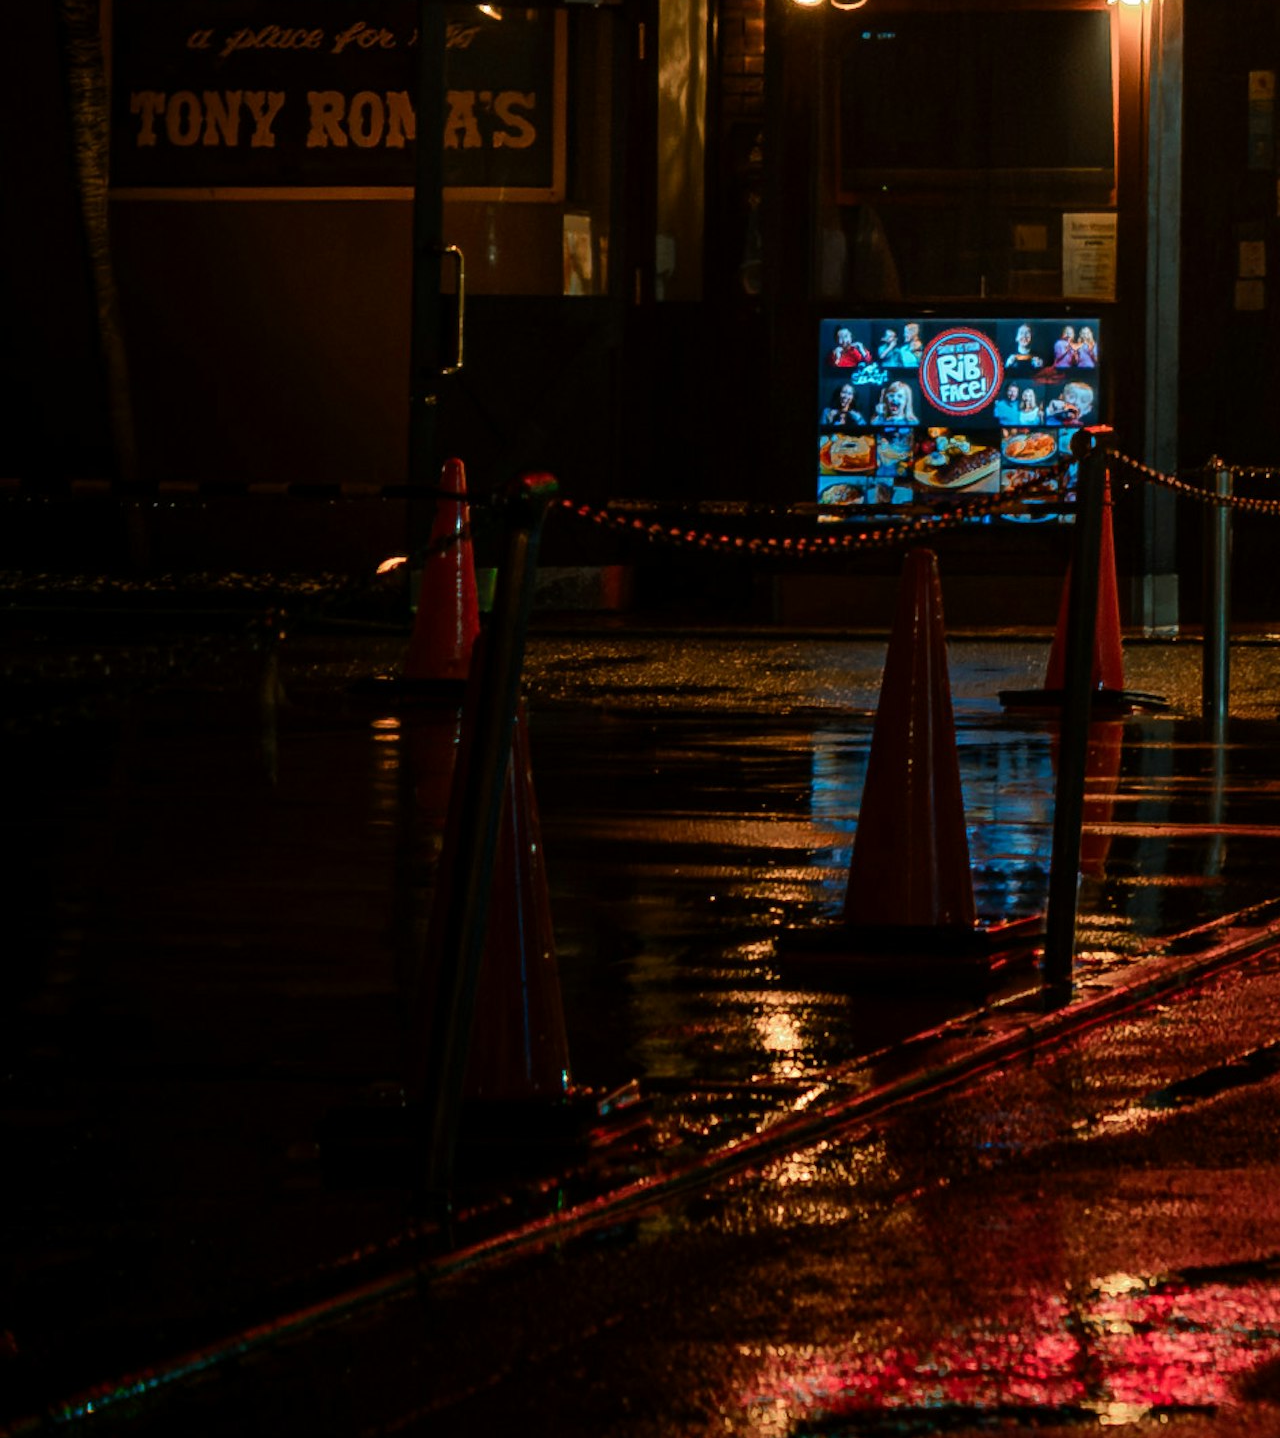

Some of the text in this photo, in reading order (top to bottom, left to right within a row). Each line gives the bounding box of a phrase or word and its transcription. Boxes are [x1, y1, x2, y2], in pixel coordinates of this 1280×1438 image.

[186, 28, 211, 48] a
[221, 24, 322, 58] place
[330, 20, 397, 54] for
[130, 89, 286, 148] TONY
